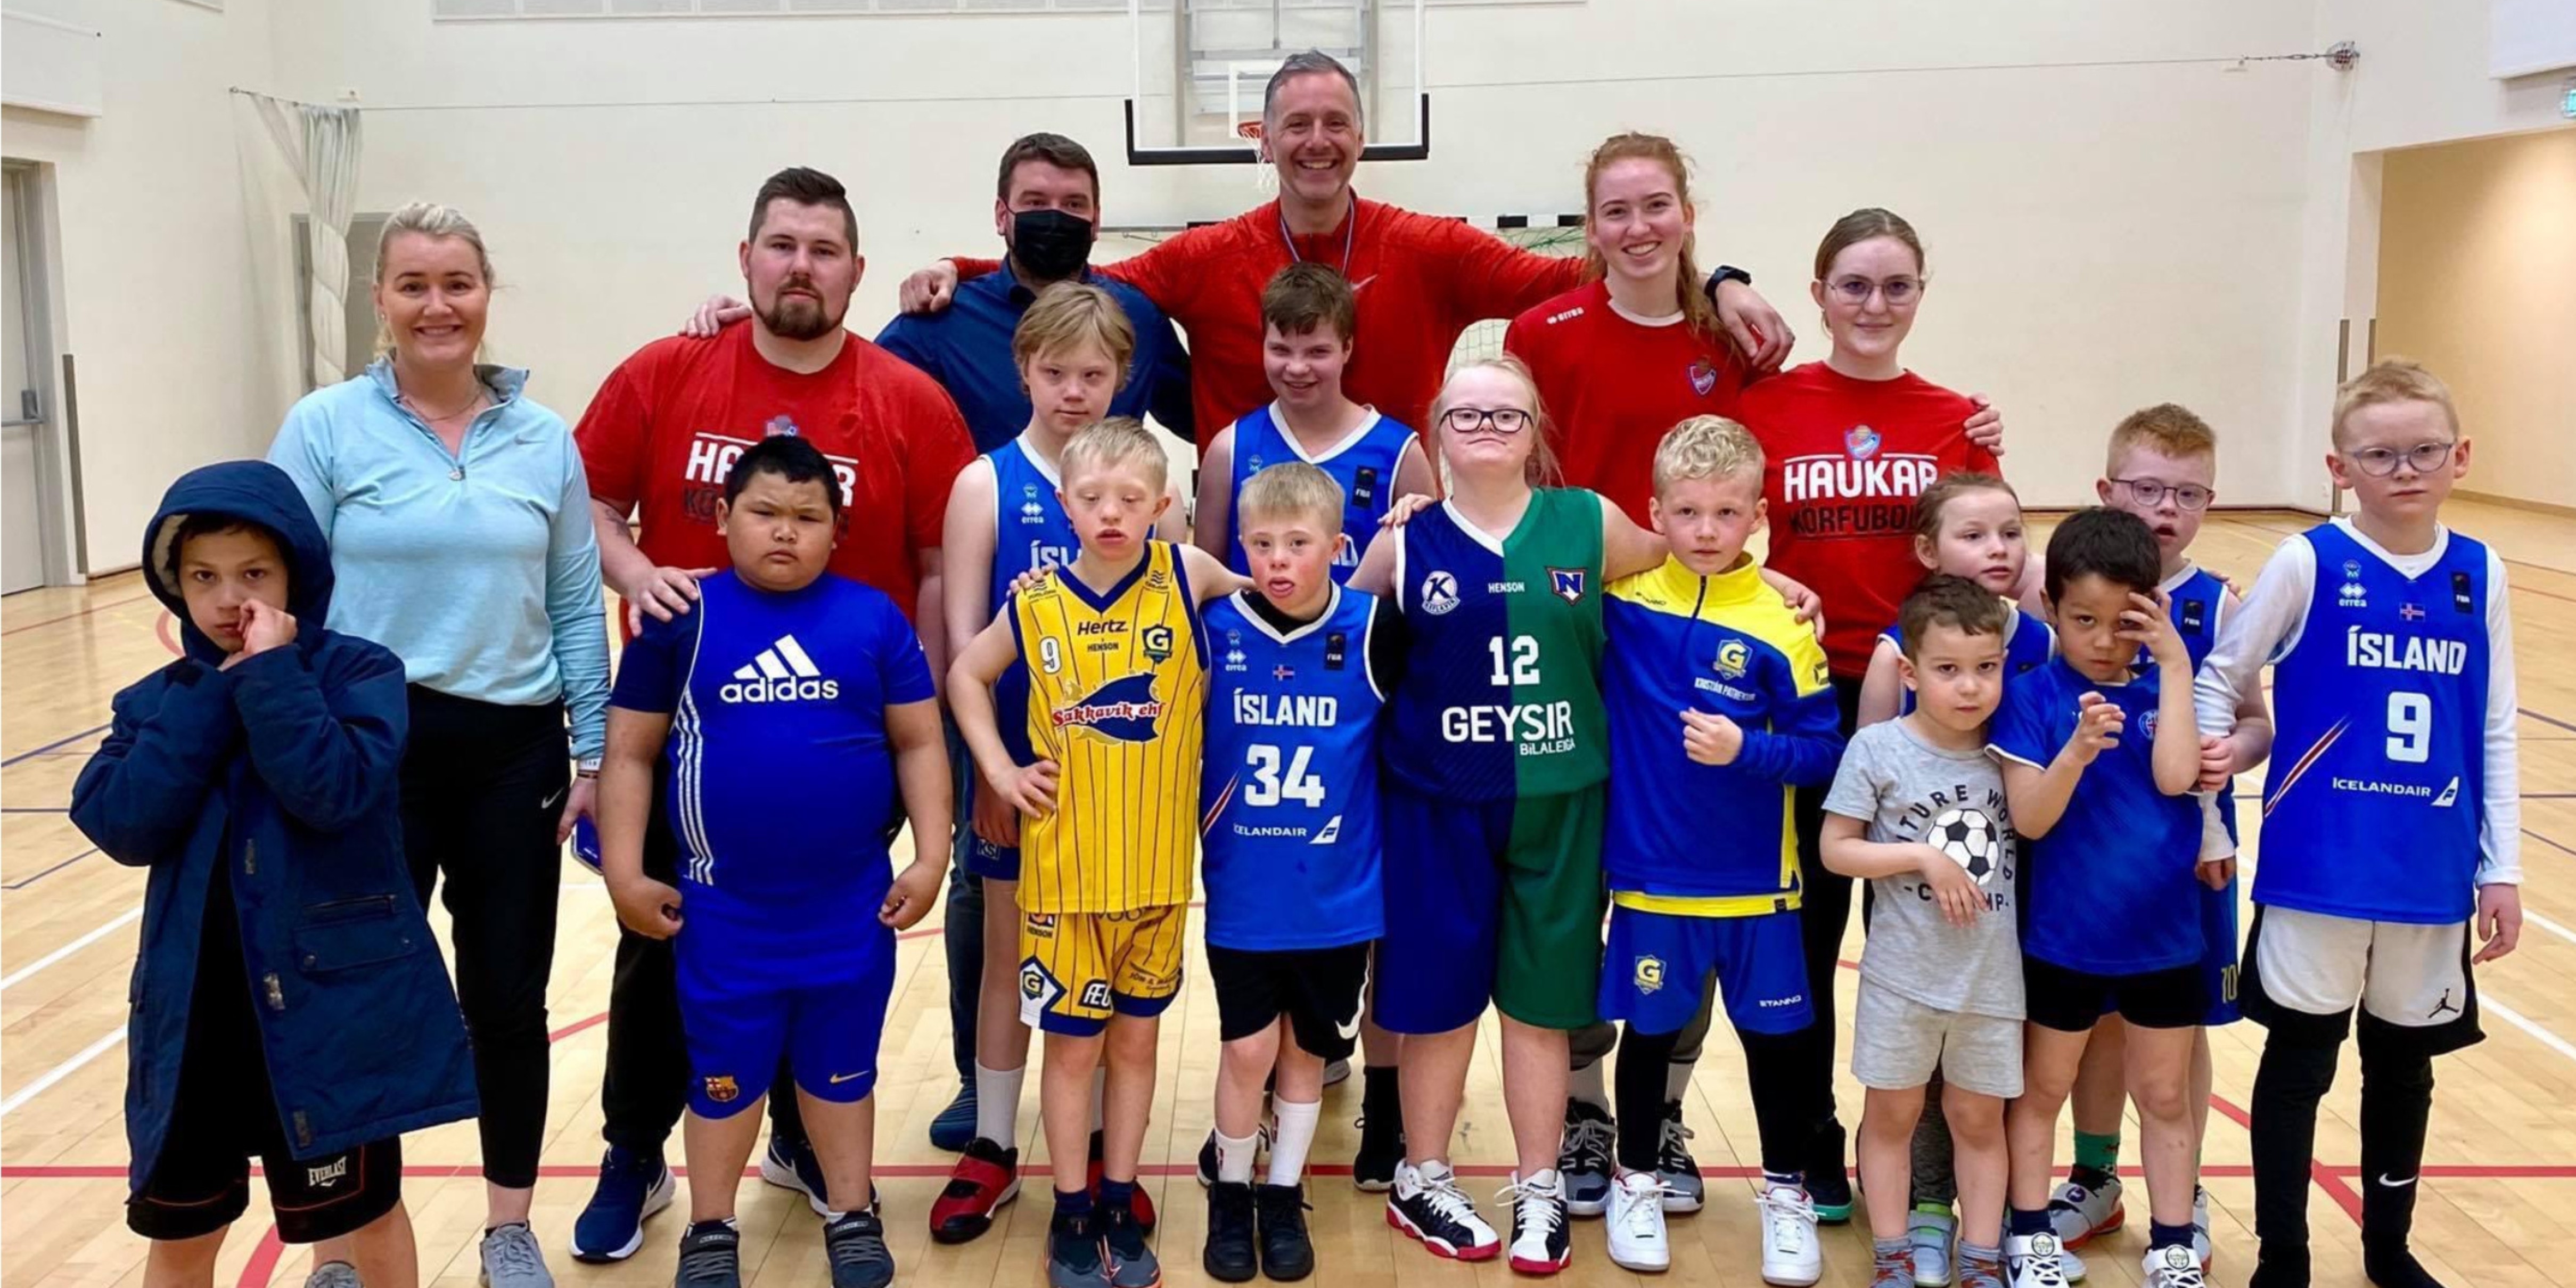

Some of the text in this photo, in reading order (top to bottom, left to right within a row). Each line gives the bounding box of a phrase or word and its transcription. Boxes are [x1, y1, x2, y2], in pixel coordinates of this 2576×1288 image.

[1427, 576, 1453, 602] K
[1488, 582, 1525, 593] HENSON
[1556, 573, 1581, 593] N
[1078, 619, 1129, 636] Hertz
[1146, 627, 1169, 651] G
[1039, 636, 1062, 674] 9
[1087, 642, 1119, 652] HENSON
[1489, 635, 1540, 686] 12
[1720, 642, 1747, 670] G
[2347, 625, 2467, 675] ÍSLAND
[720, 675, 839, 703] adidas
[1233, 687, 1338, 727] ÍSLAND
[1442, 700, 1574, 742] GEYSIR
[2385, 691, 2432, 763] 9
[1244, 744, 1325, 808] 34
[2332, 777, 2432, 797] ICELANDAIR
[1024, 974, 1041, 990] G
[1637, 959, 1660, 983] G
[308, 1155, 347, 1186] EVERLAST
